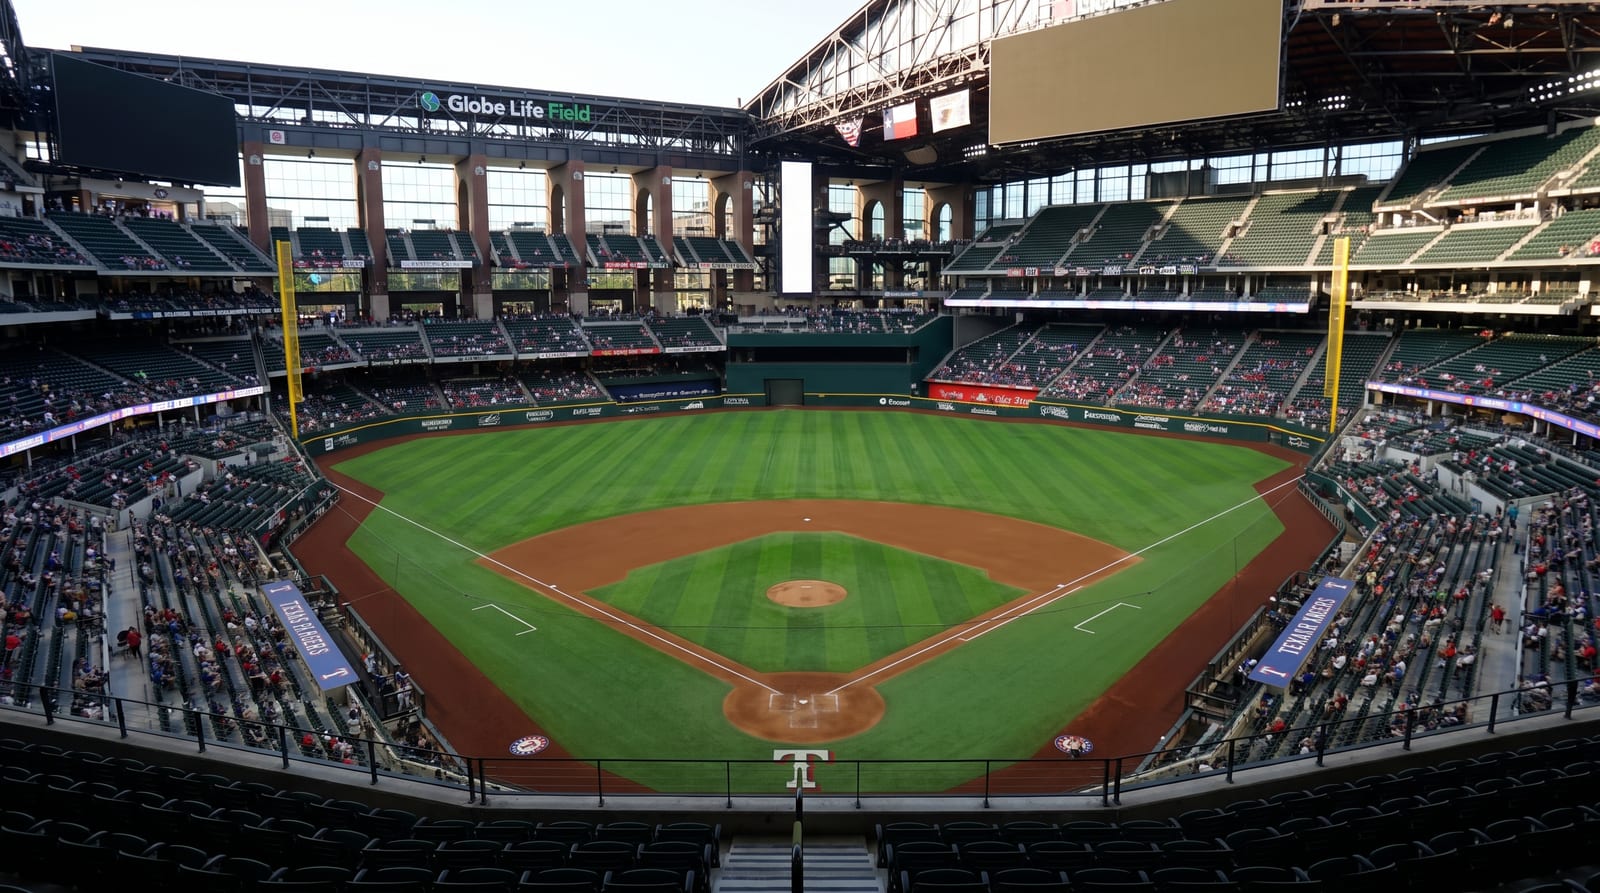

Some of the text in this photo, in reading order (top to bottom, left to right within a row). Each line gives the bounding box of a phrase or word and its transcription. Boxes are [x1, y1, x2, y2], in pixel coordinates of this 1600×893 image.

[448, 95, 591, 122] Globe Life Field
[322, 667, 349, 680] T
[1260, 666, 1288, 678] T
[773, 749, 832, 790] T
